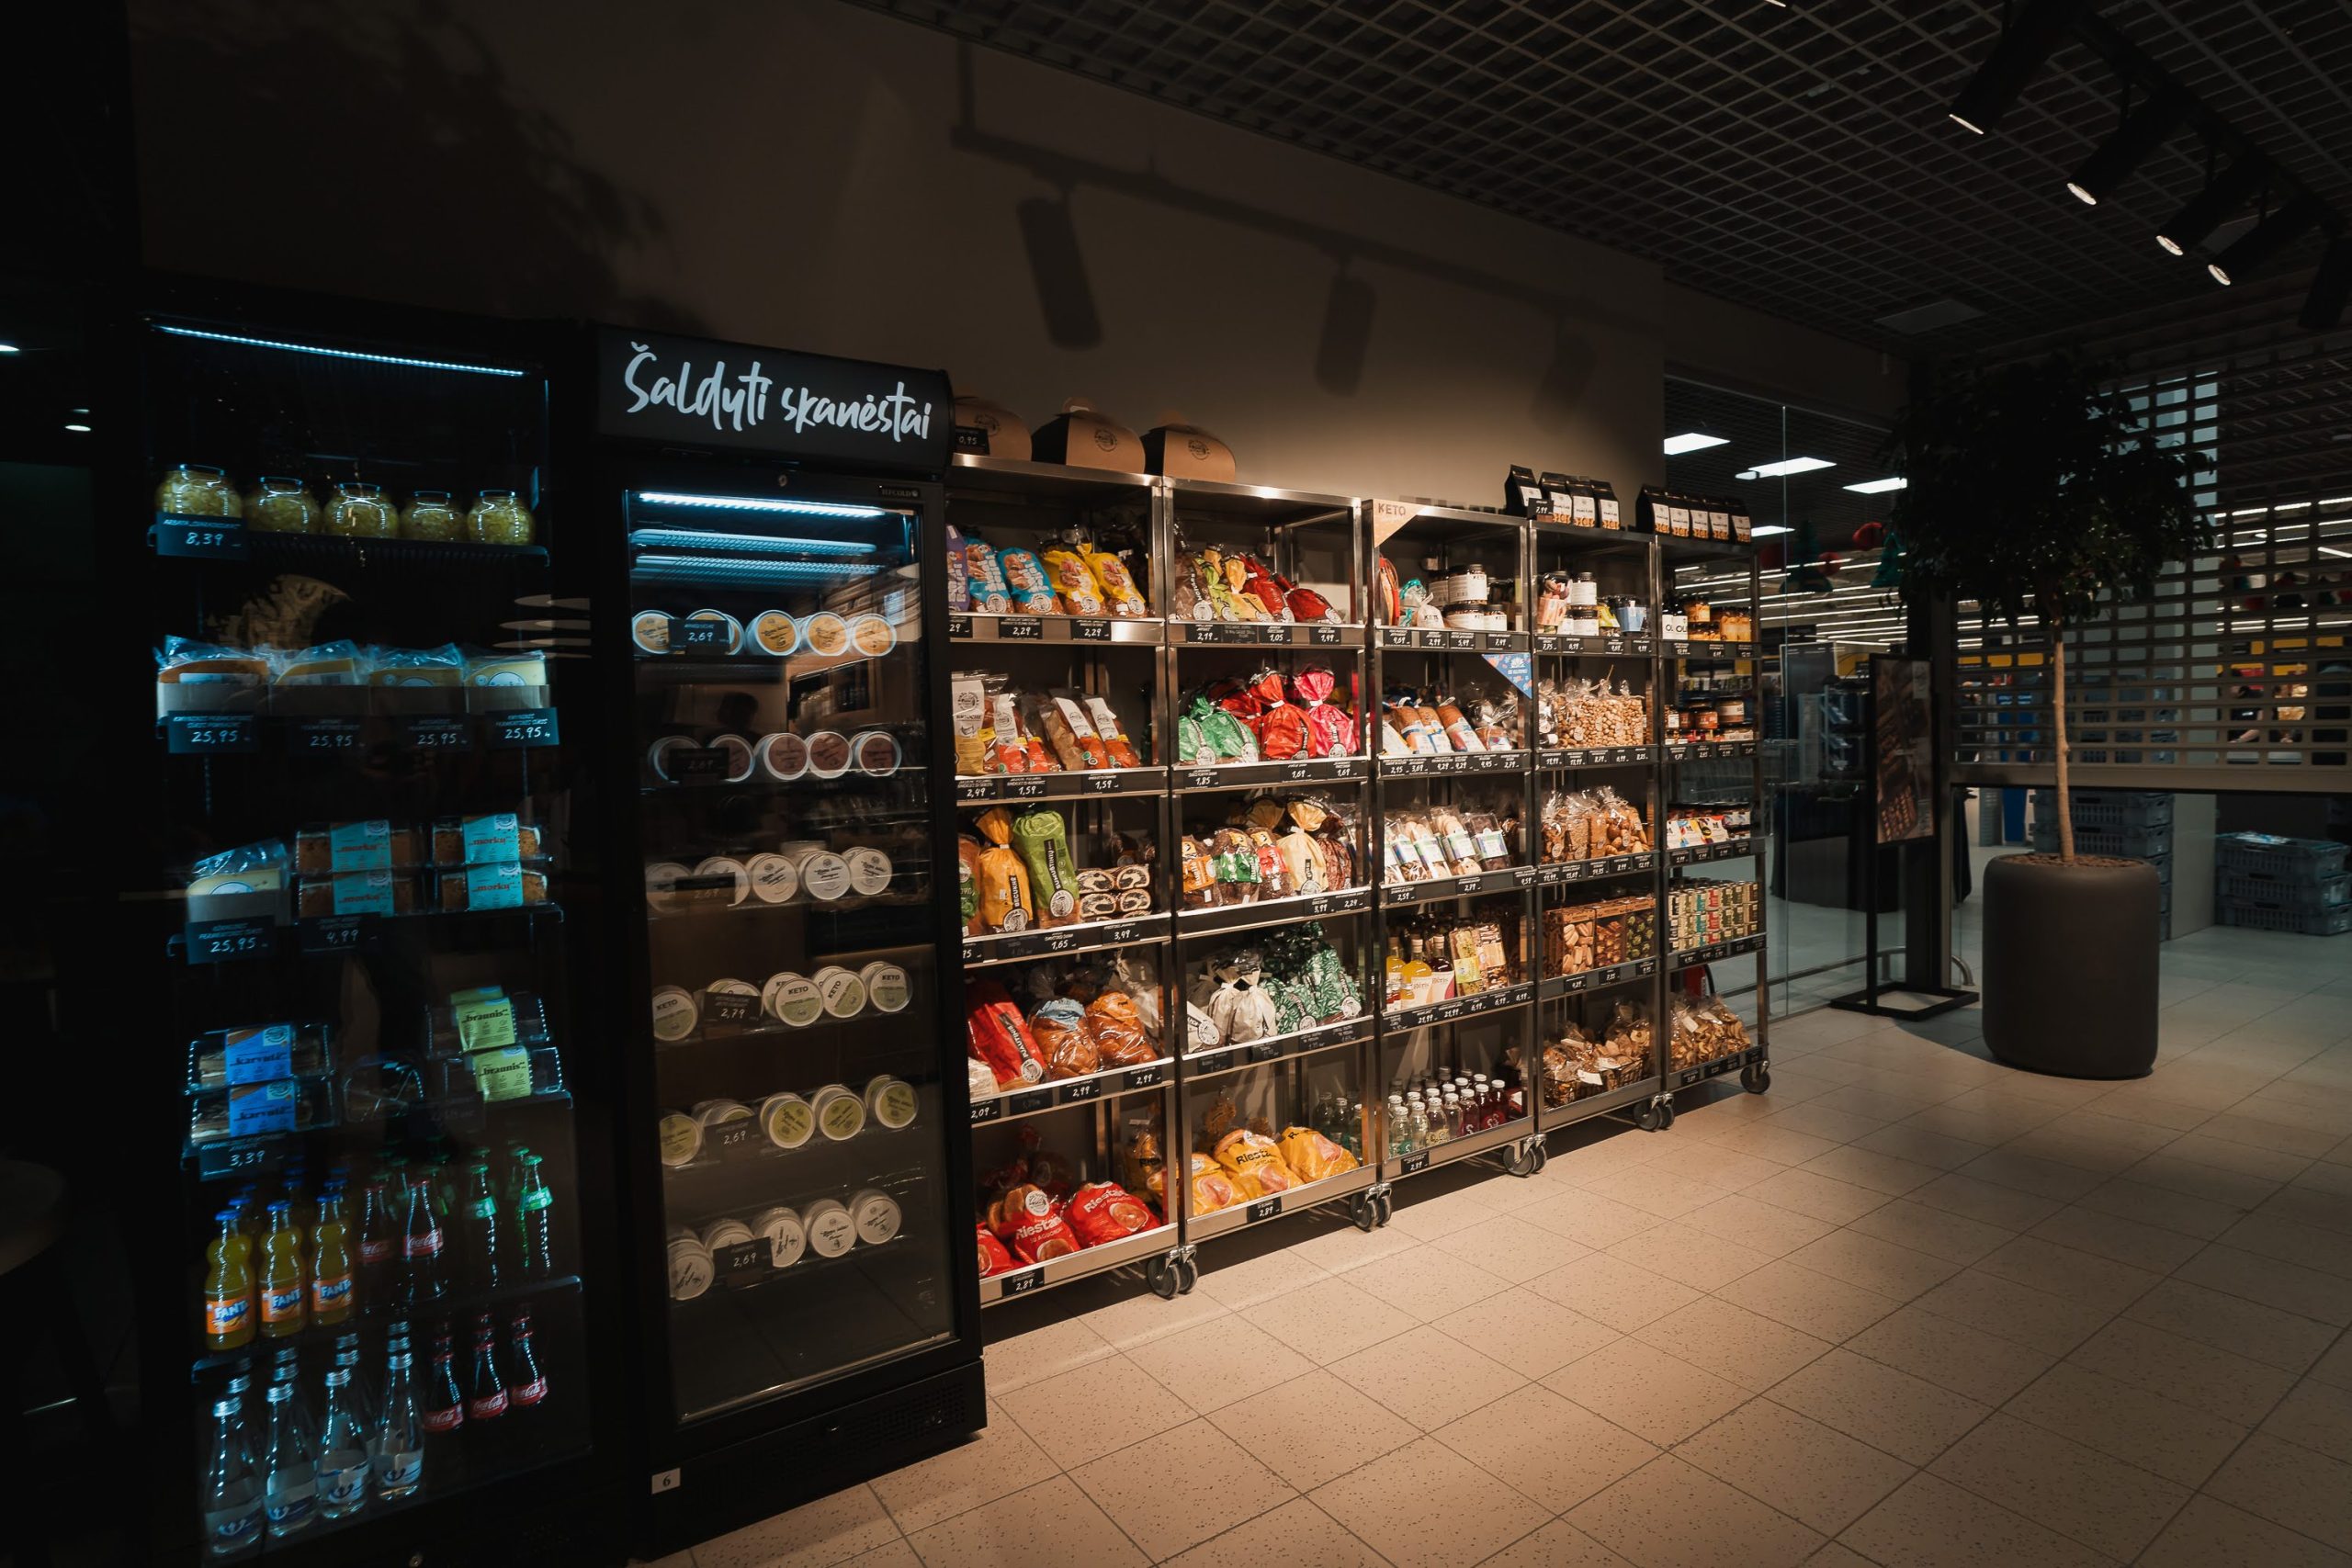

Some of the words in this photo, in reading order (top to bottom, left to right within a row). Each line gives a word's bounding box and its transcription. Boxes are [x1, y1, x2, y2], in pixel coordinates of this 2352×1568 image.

[625, 341, 773, 432] Šaldyti
[779, 381, 932, 443] skanėstai
[1378, 502, 1406, 515] KETO
[186, 532, 223, 546] 8,39
[688, 632, 714, 642] 2,69
[1012, 627, 1031, 637] 2,29
[1084, 629, 1102, 637] 2,29
[1197, 632, 1214, 641] 2,19
[1269, 634, 1283, 642] 1,05
[191, 730, 239, 744] 25,95
[504, 727, 542, 739] 25,95
[310, 735, 354, 748] 25,95
[418, 733, 457, 746] 25,95
[1019, 785, 1036, 796] 1,59
[1095, 780, 1113, 790] 1,59
[327, 929, 359, 944] 4,99
[210, 937, 257, 953] 25,95
[1052, 940, 1068, 951] 1,65
[788, 986, 808, 995] KETO
[828, 980, 842, 998] KETO
[657, 998, 678, 1010] KETO
[720, 1008, 746, 1020] 2,79
[1136, 1074, 1153, 1085] 2,99
[1073, 1086, 1090, 1097] 2,99
[971, 1107, 989, 1120] 2,09
[724, 1130, 746, 1145] 2,69
[230, 1150, 265, 1168] 3,39
[1260, 1206, 1273, 1218] 2,89
[733, 1252, 756, 1268] 2,69
[276, 1288, 302, 1308] FANT
[662, 1475, 672, 1486] 6
